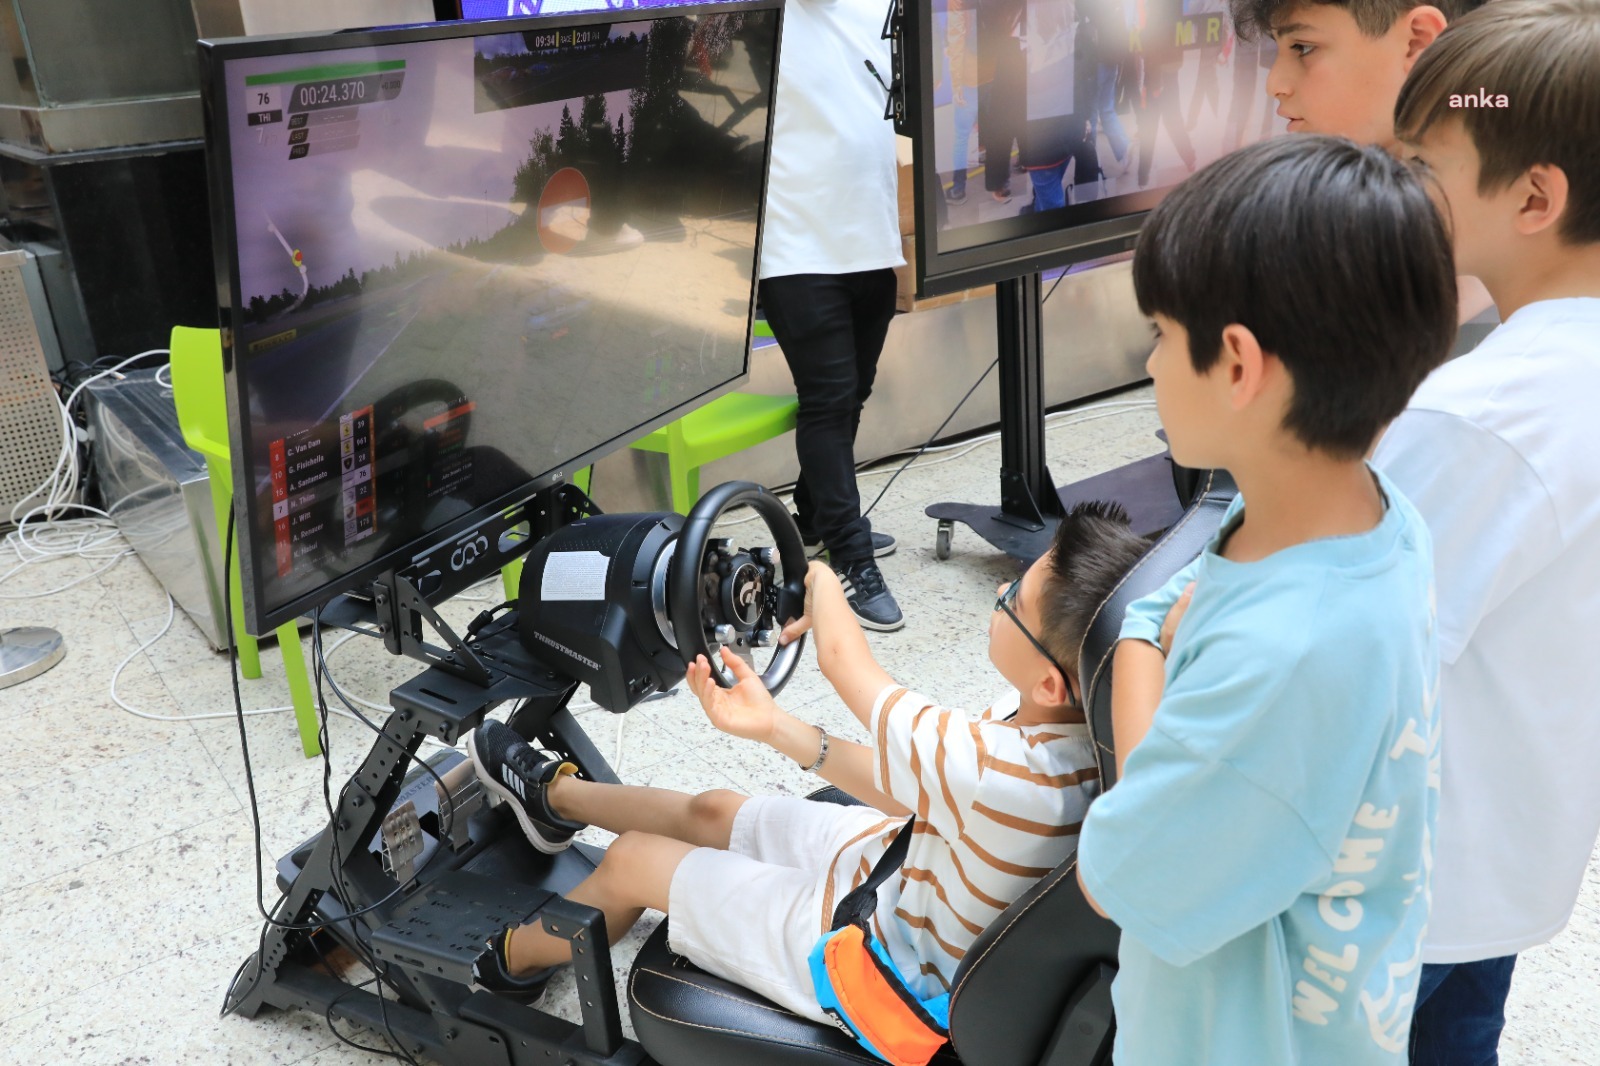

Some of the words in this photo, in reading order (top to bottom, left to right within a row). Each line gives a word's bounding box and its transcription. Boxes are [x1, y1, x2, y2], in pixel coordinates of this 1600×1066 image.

[536, 34, 555, 48] 09:34
[577, 32, 591, 43] 2:01
[257, 93, 270, 105] 76
[300, 80, 366, 106] 00:24.370
[258, 113, 272, 122] THI
[295, 443, 307, 454] Van
[274, 470, 283, 480] 10
[275, 487, 284, 497] 15
[289, 483, 297, 492] A.
[278, 506, 283, 514] 7
[359, 470, 367, 479] 76
[534, 631, 600, 671] THRUSTMASTER
